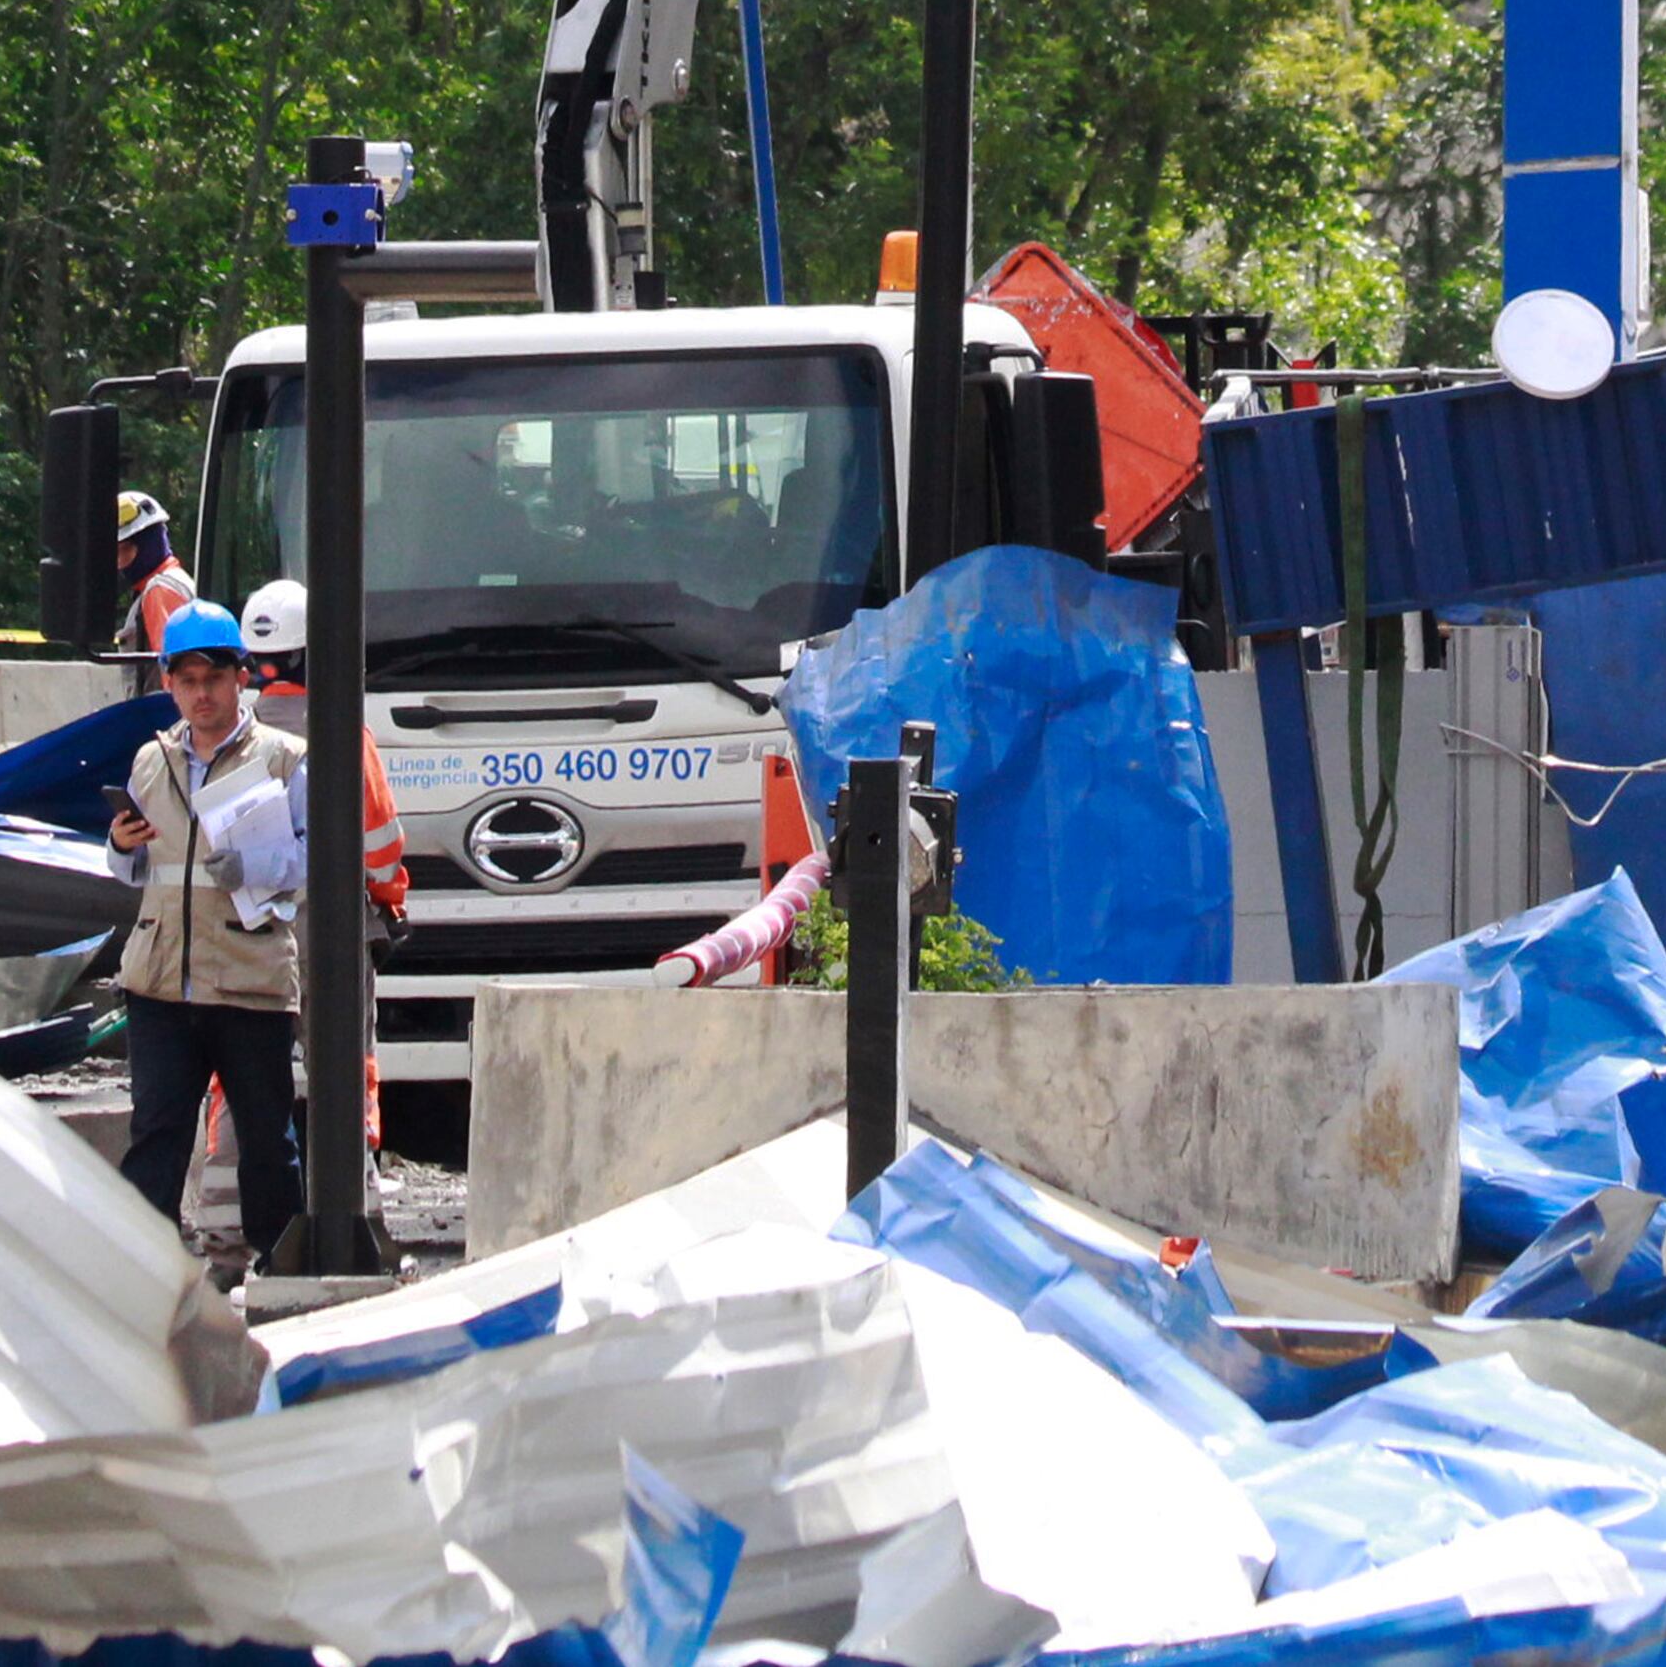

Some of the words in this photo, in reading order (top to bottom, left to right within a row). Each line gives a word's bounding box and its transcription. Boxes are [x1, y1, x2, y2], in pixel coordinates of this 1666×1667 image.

[441, 754, 463, 770] de
[481, 753, 544, 786] 350
[554, 748, 618, 782] 460
[628, 746, 713, 780] 9707
[386, 770, 479, 790] mergencia
